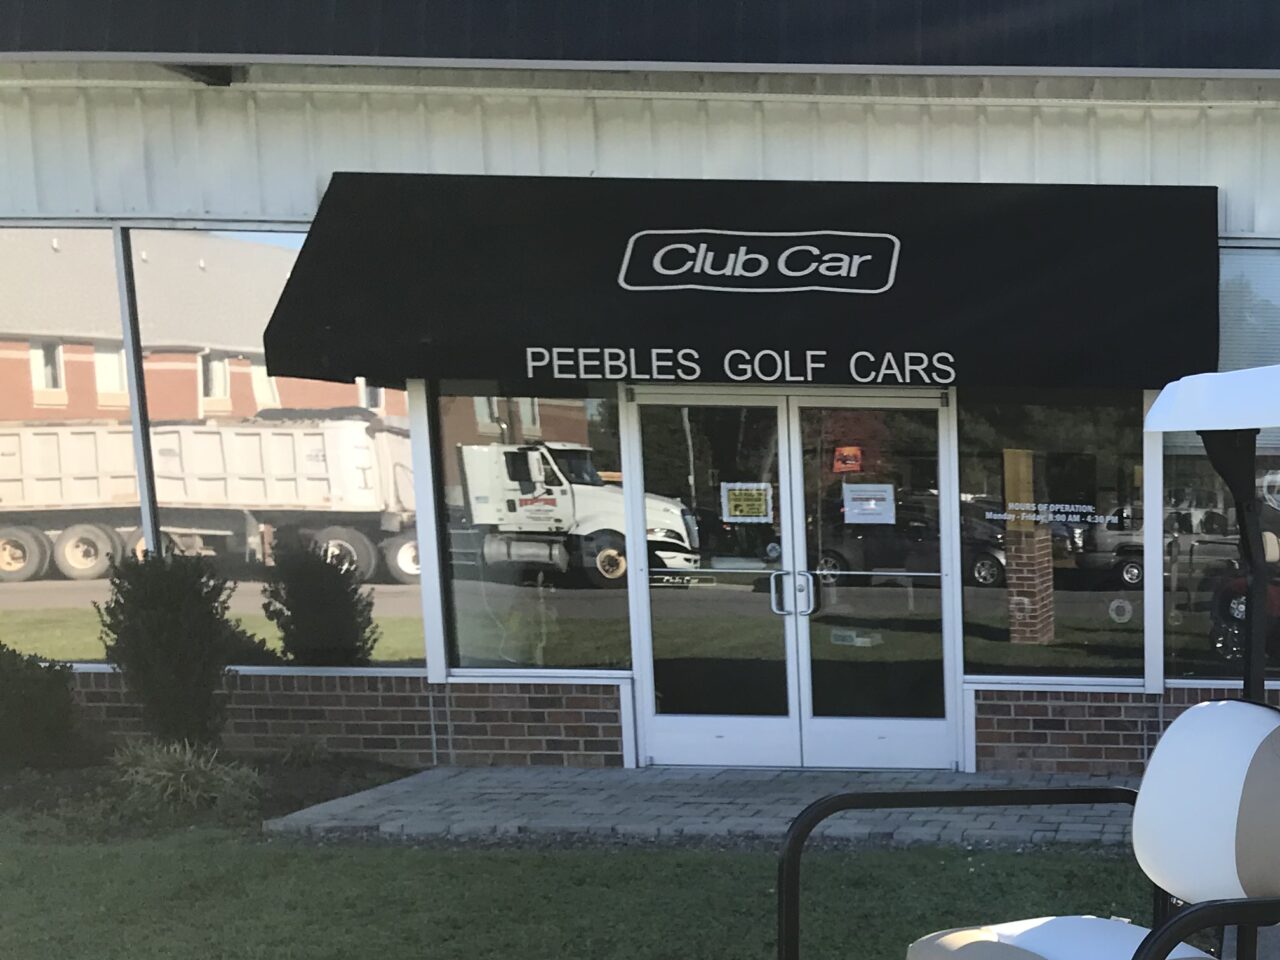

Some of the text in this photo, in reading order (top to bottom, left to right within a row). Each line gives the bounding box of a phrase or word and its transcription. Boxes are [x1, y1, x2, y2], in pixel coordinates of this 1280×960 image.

[652, 243, 872, 277] Club Car
[525, 346, 957, 384] PEEBLES GOLF CARS
[1037, 503, 1048, 512] OF
